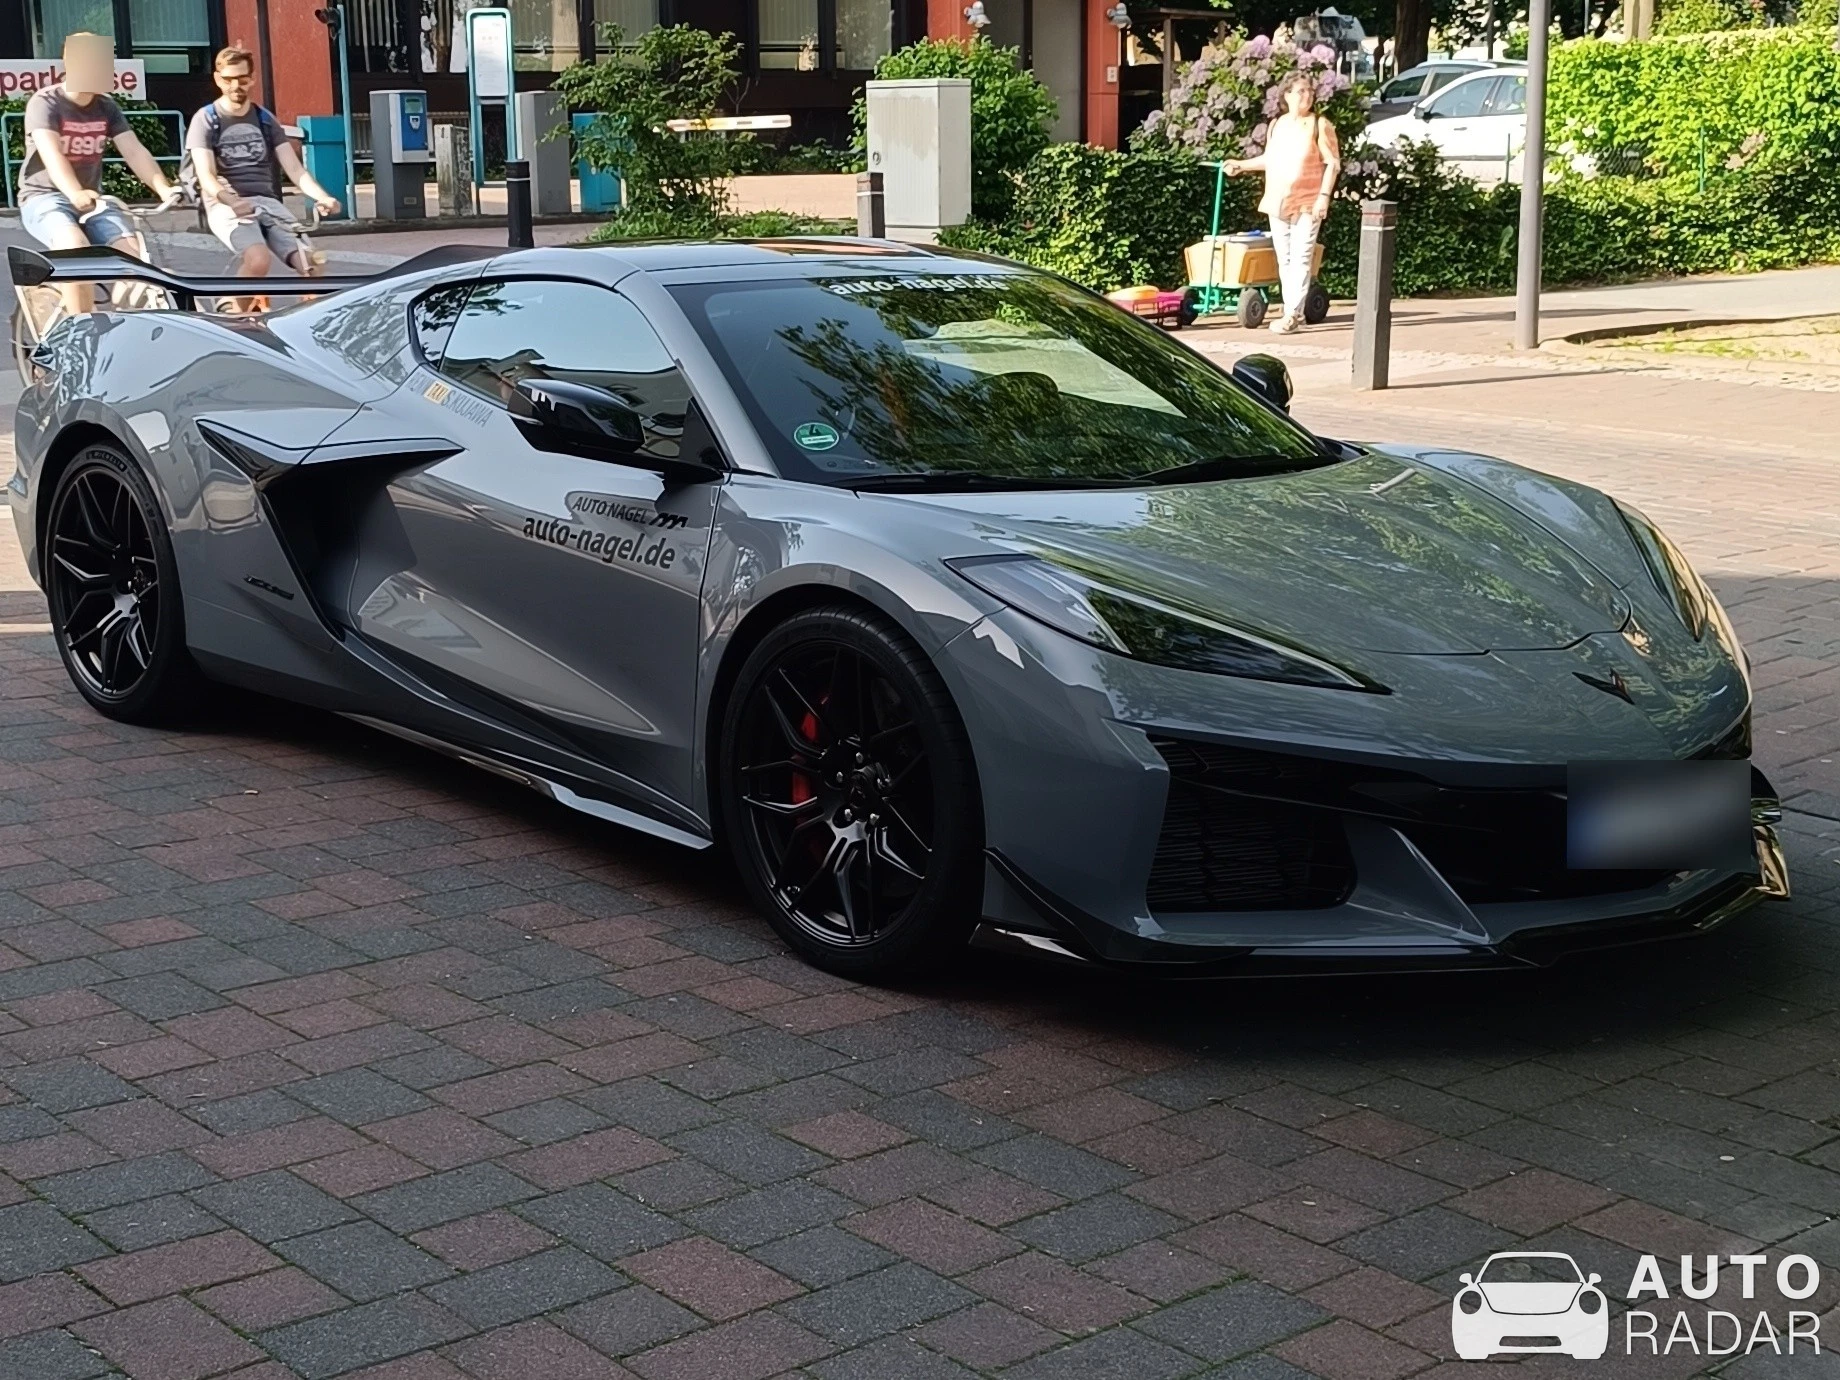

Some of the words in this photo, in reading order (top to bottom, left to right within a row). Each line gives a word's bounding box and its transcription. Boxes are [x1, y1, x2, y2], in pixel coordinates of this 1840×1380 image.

[828, 275, 1010, 295] auto-nagel.de
[573, 496, 607, 515] AUTO
[607, 503, 648, 525] NAGEL
[522, 517, 676, 570] auto-nagel.de
